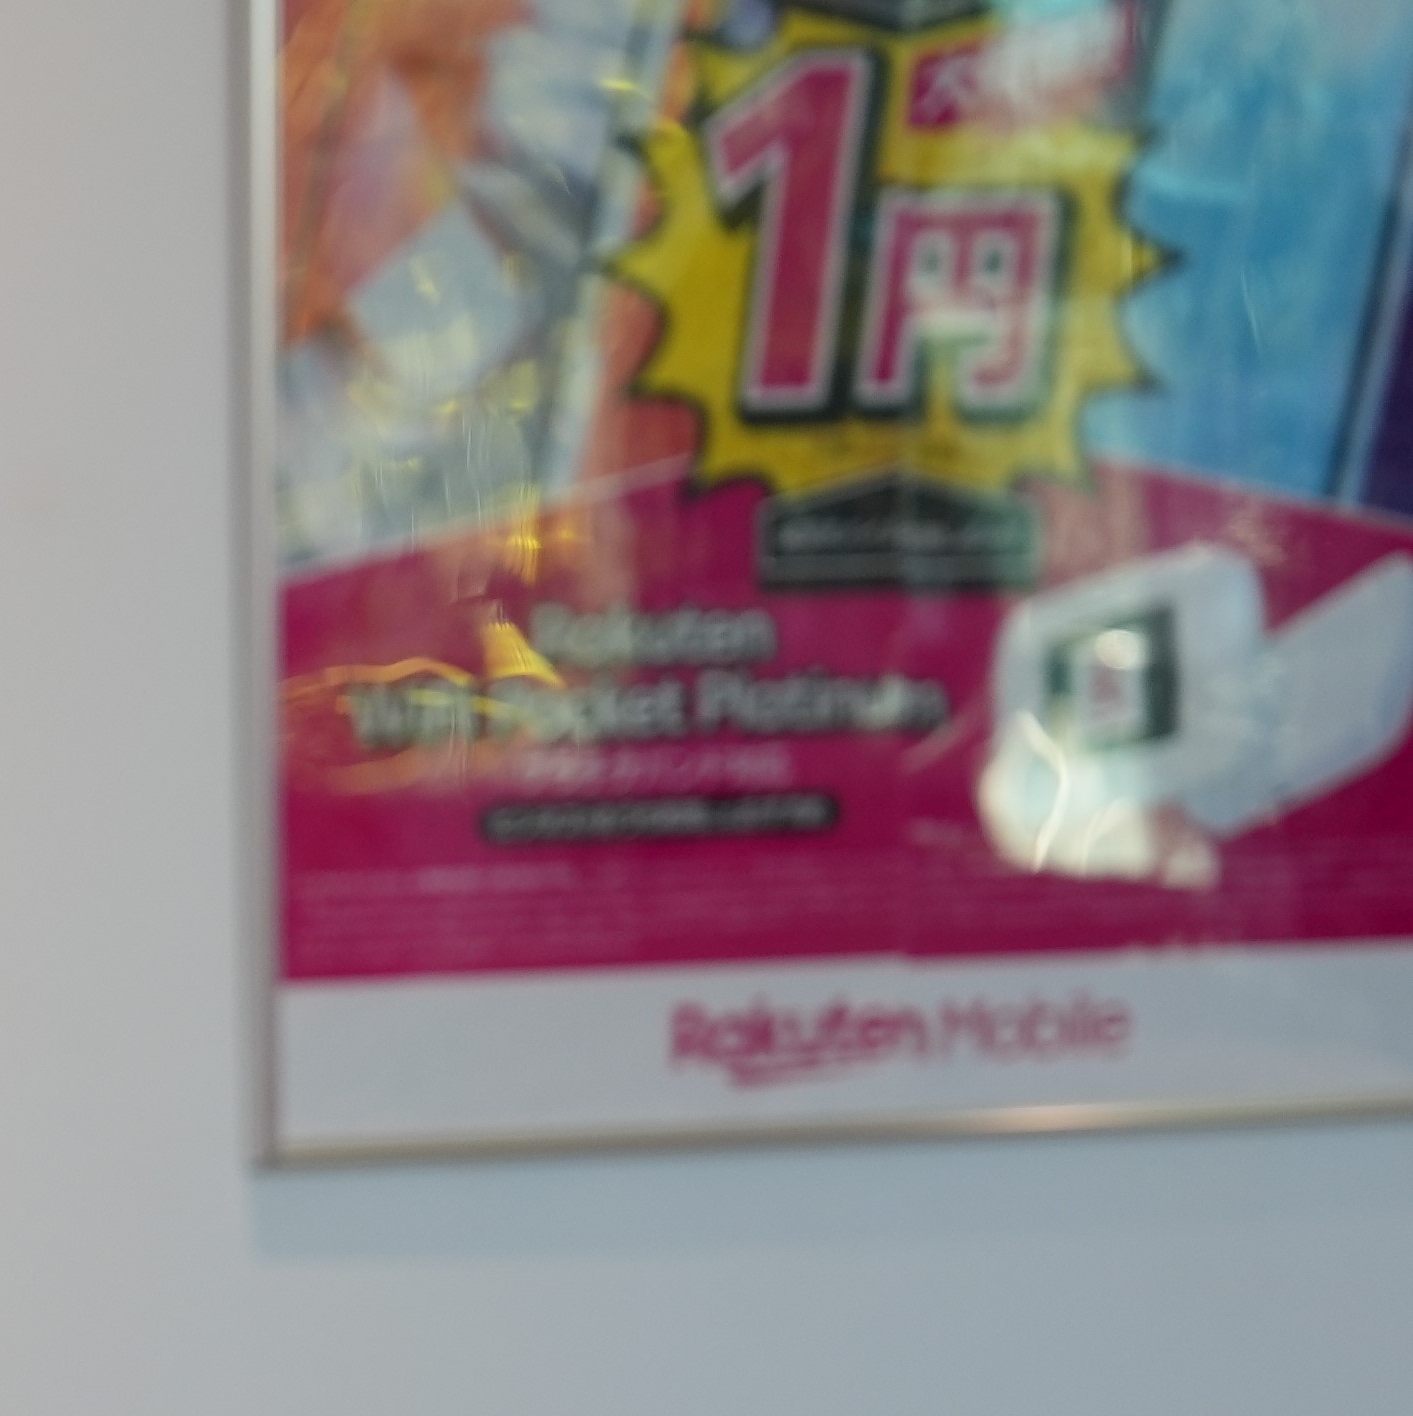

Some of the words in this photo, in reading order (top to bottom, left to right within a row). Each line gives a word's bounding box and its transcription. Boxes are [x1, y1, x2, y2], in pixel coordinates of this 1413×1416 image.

[527, 601, 779, 669] Rakuten
[695, 666, 949, 735] Platinum
[669, 1002, 931, 1087] Rakuten
[936, 997, 1130, 1064] Mobile
